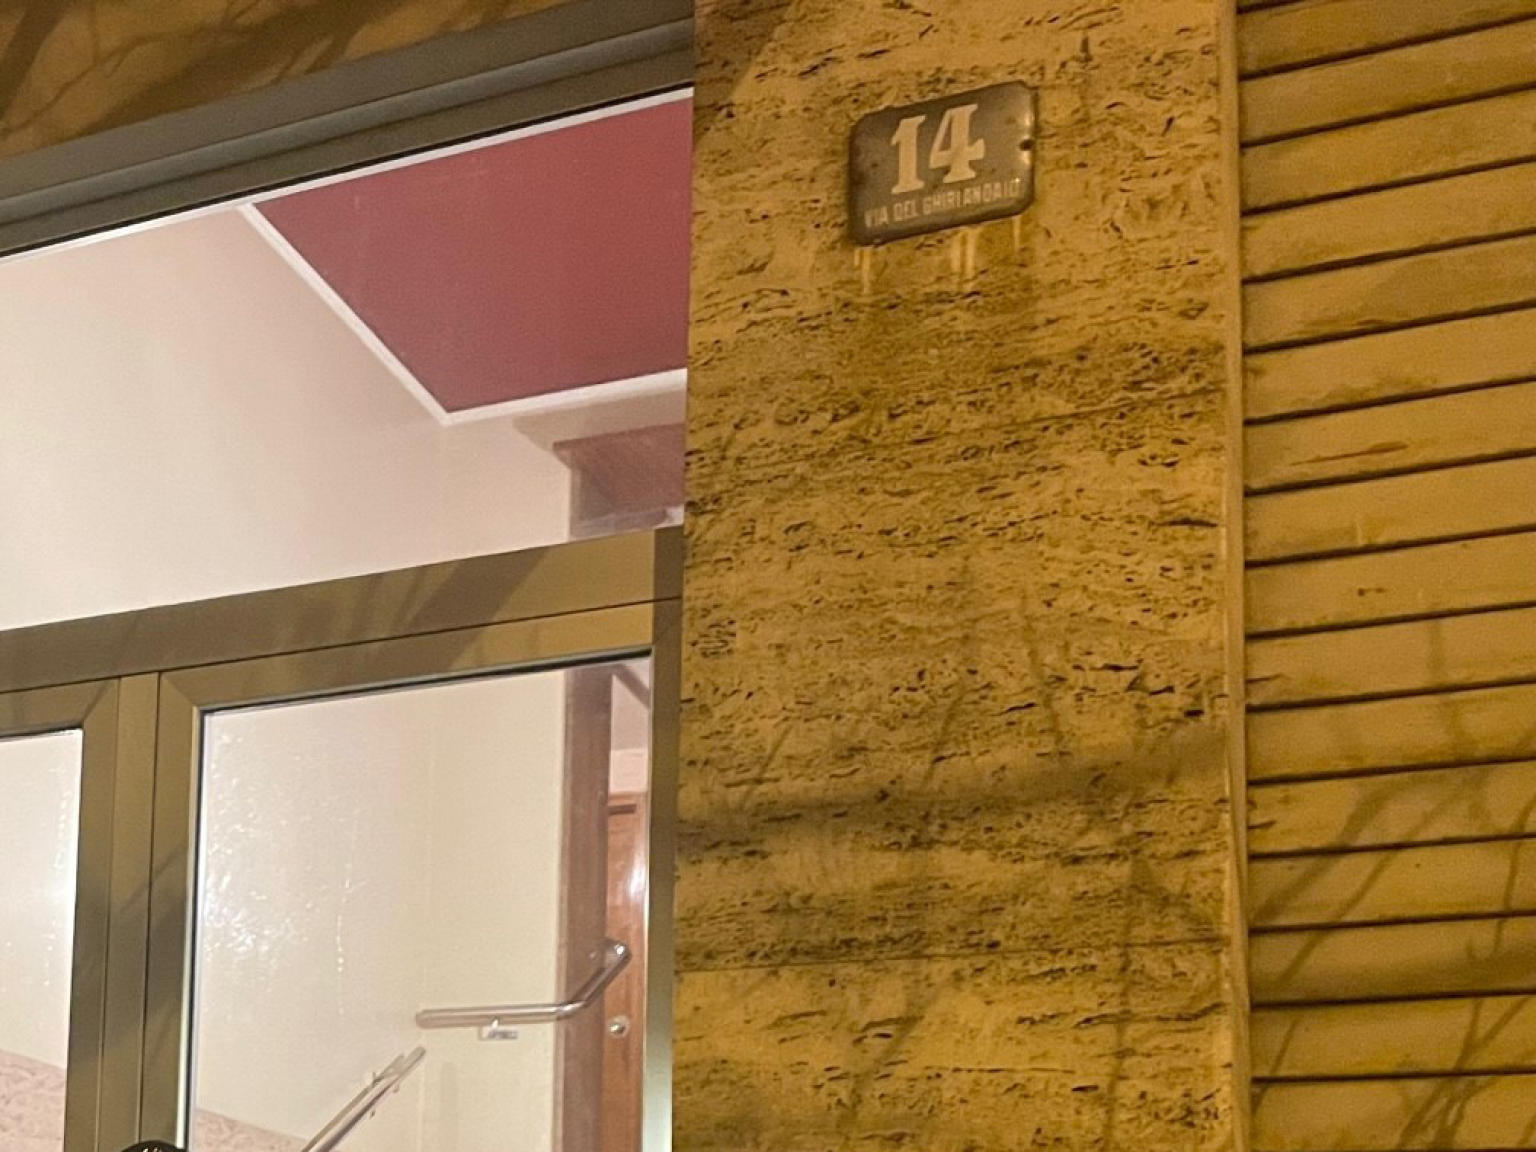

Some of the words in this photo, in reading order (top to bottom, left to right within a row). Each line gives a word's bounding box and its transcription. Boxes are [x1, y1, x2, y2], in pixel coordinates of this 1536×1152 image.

[891, 103, 985, 194] 14
[866, 206, 889, 228] VIA
[893, 199, 919, 222] DEL
